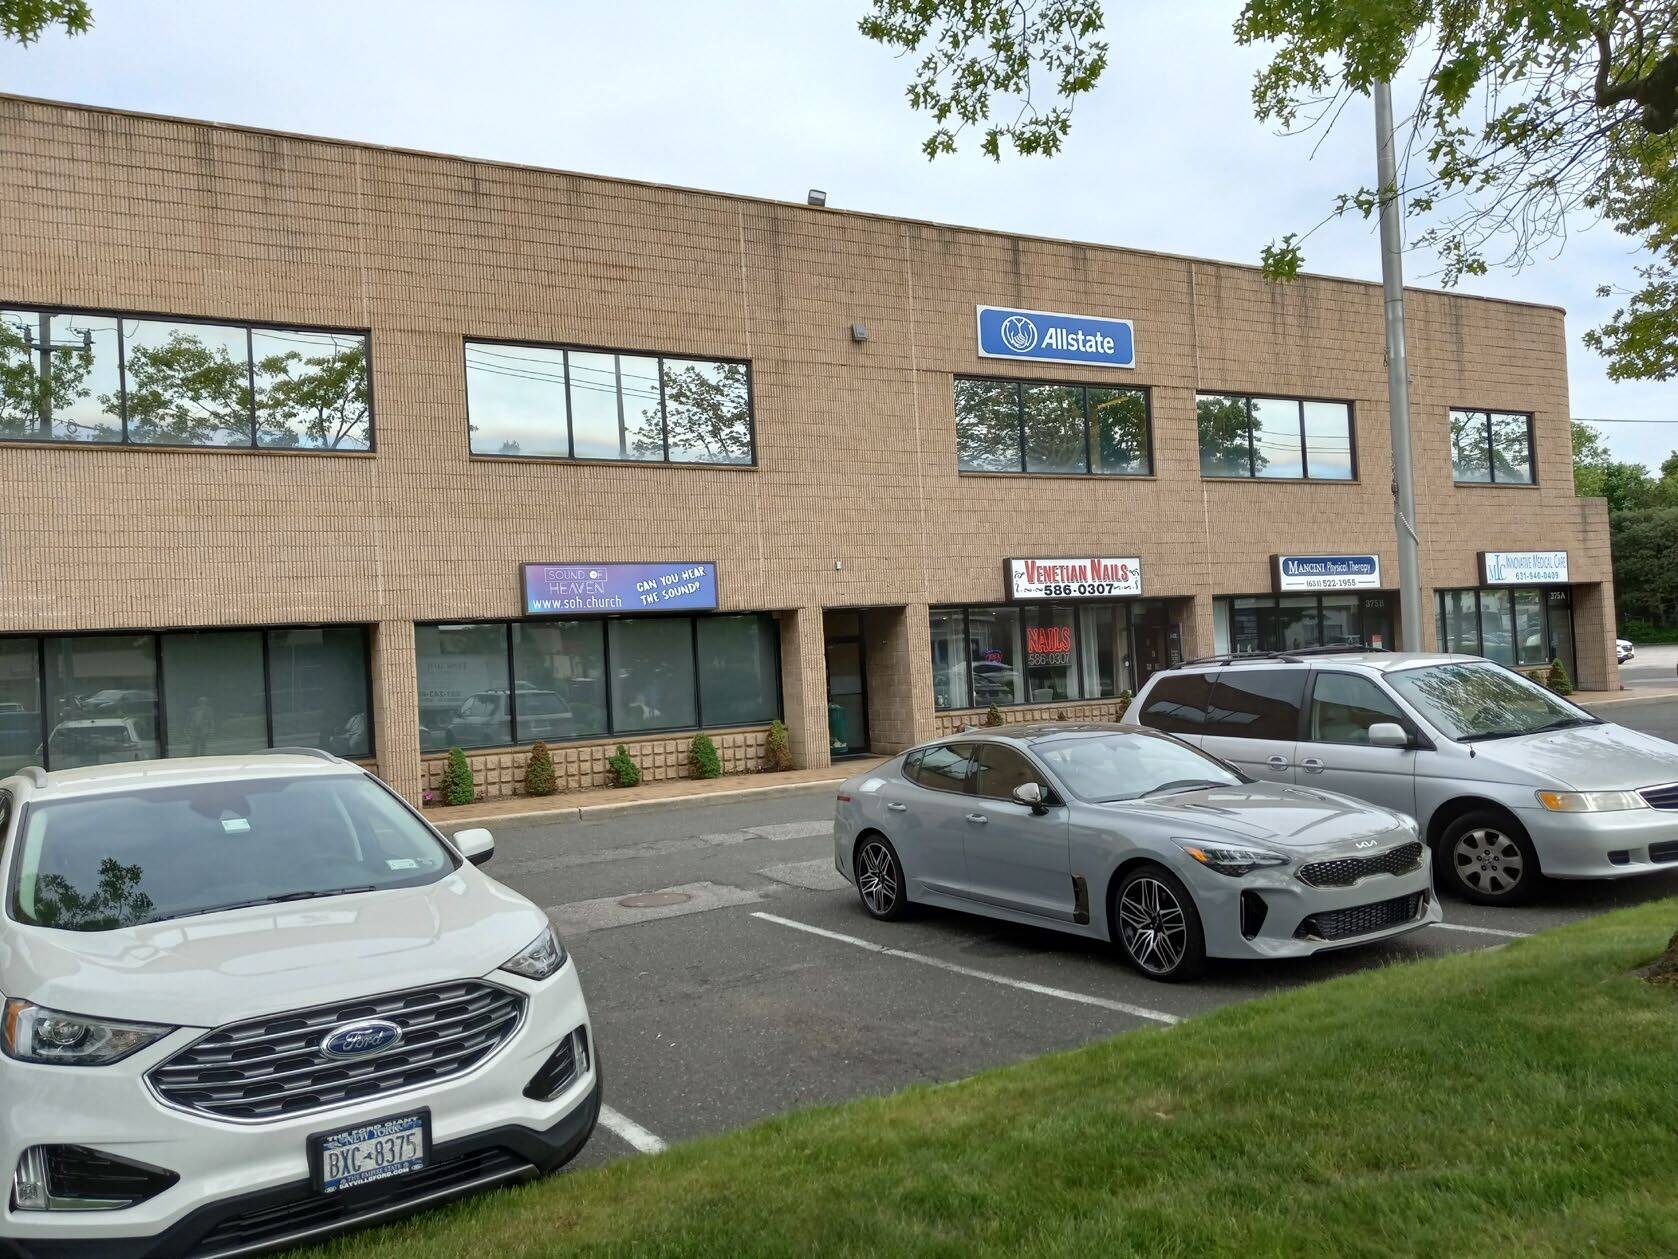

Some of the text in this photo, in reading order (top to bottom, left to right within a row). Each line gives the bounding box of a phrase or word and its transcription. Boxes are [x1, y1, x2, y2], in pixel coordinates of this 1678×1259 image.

[1041, 327, 1115, 354] Allstate
[549, 569, 585, 580] SOUND
[1024, 558, 1129, 584] VENETIAN NAILS
[1288, 560, 1325, 574] MANCINI
[549, 582, 605, 595] HEAVEN
[636, 566, 707, 593] CAN YOU HEAR
[532, 595, 622, 609] www.soh.church
[640, 582, 701, 606] THE SOUND?
[1026, 626, 1072, 654] NAILS
[343, 1029, 384, 1050] Ford
[352, 1124, 381, 1134] FORD
